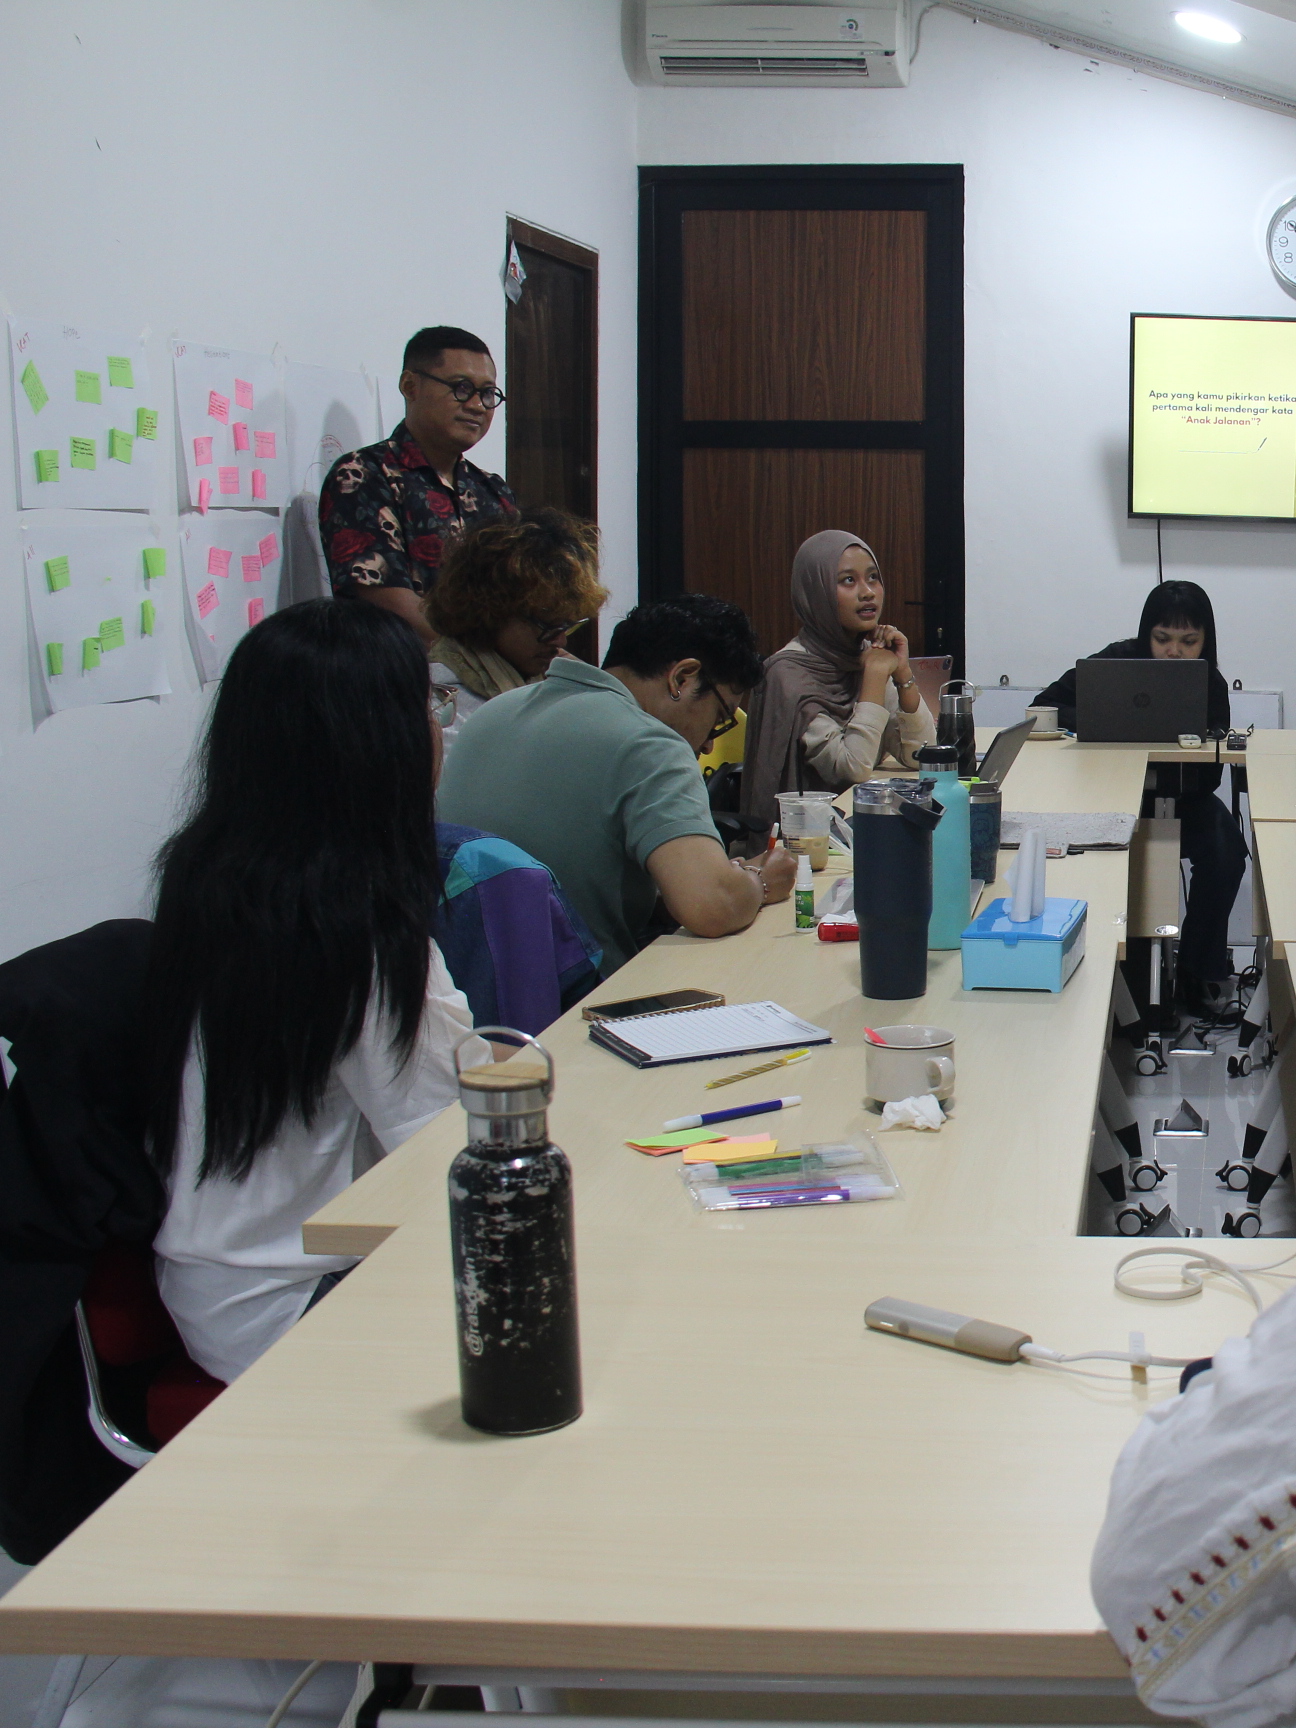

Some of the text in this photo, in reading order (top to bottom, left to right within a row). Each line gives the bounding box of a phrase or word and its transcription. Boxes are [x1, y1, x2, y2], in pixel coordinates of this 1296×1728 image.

[1284, 220, 1296, 231] 10
[1279, 238, 1288, 247] 9
[1284, 252, 1293, 263] 8
[1149, 390, 1296, 403] Apa yang kamu pikirkan ketika
[1153, 403, 1293, 416] pertama kali mendengar kata
